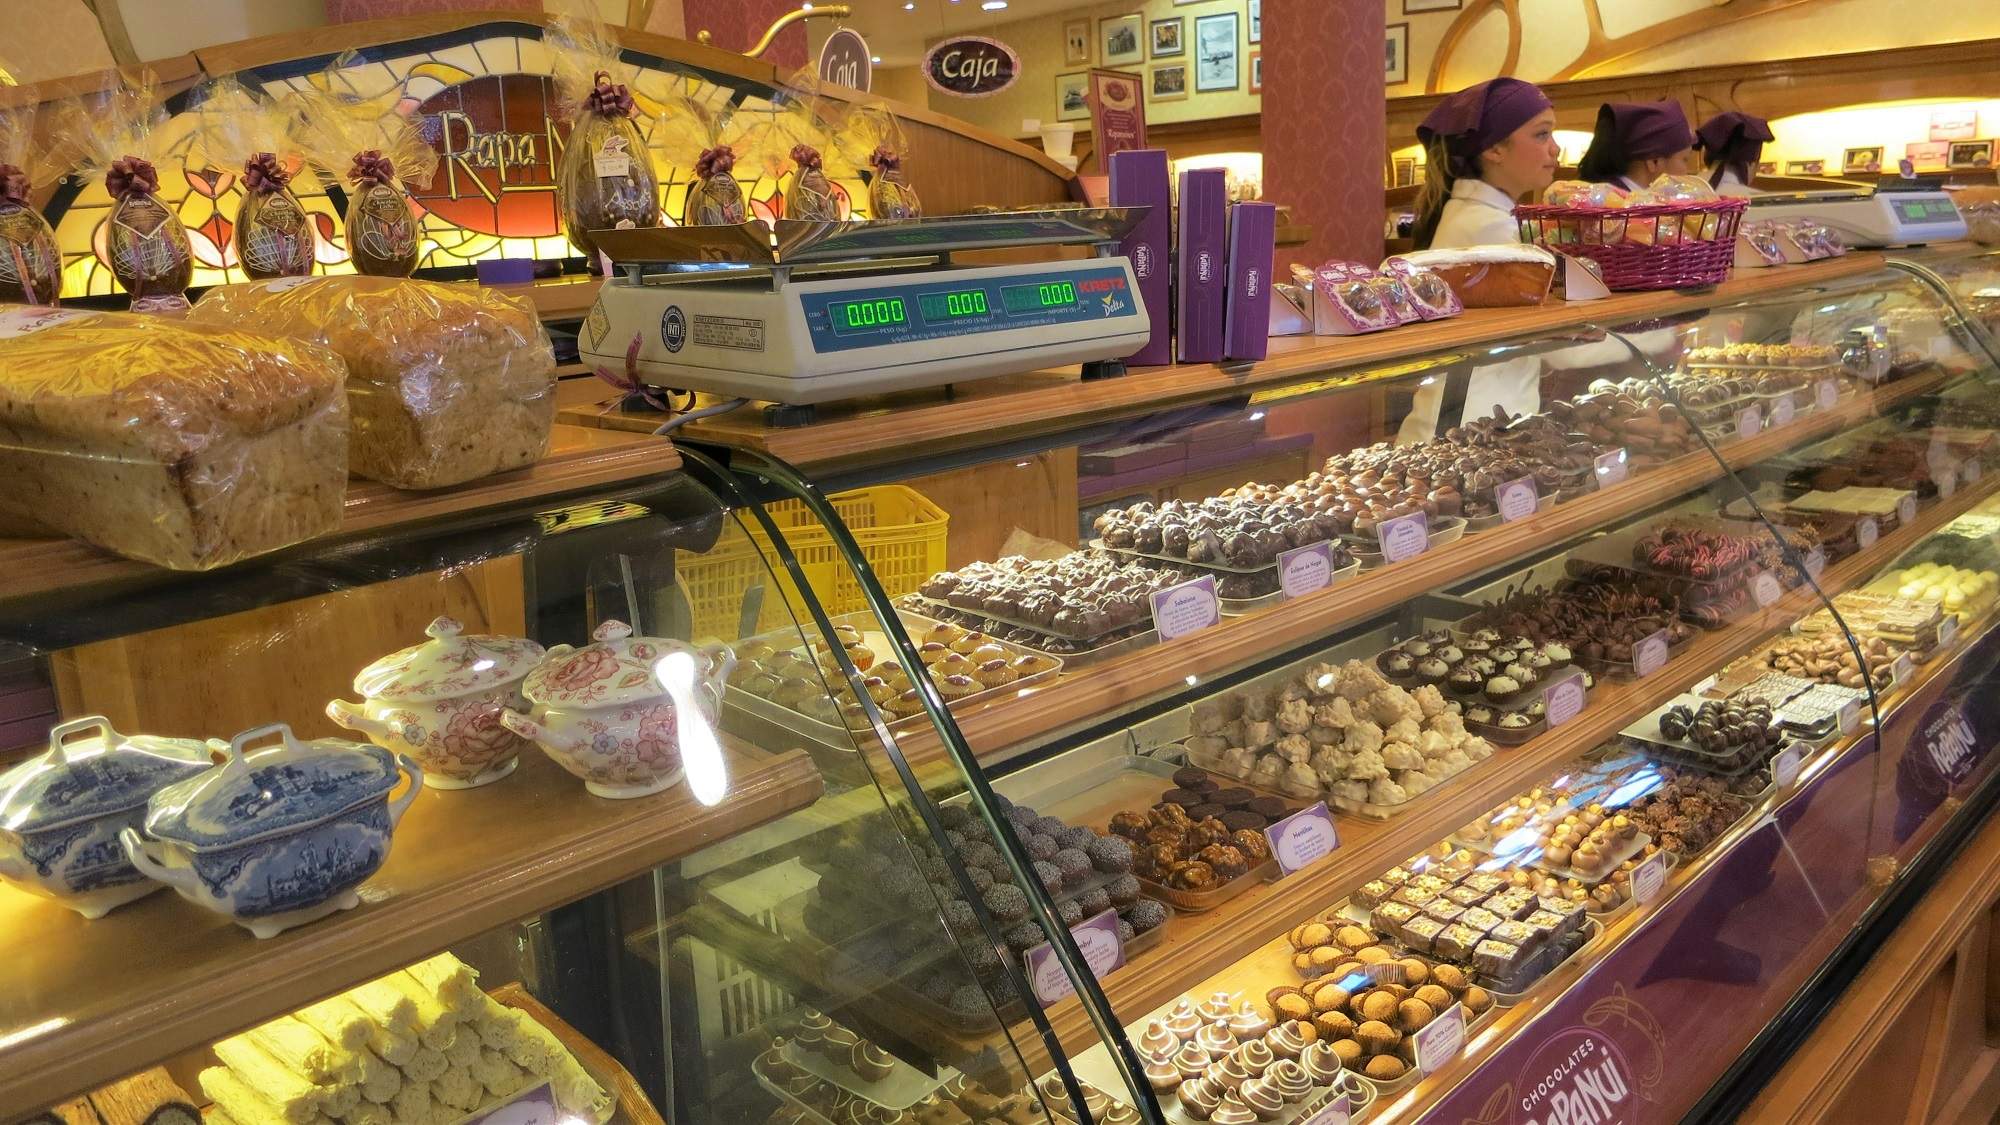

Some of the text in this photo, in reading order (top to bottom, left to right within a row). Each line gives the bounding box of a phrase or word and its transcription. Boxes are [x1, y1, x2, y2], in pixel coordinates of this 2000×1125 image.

[827, 51, 857, 90] Caja
[942, 50, 999, 88] Caja
[441, 111, 536, 204] Rapa
[948, 292, 986, 315] 0.00
[1040, 283, 1074, 305] 0.00
[1102, 299, 1125, 317] Delta
[847, 300, 904, 327] 0.000
[1522, 1038, 1594, 1112] CHOCOLATES
[1524, 1045, 1629, 1125] PANUI
